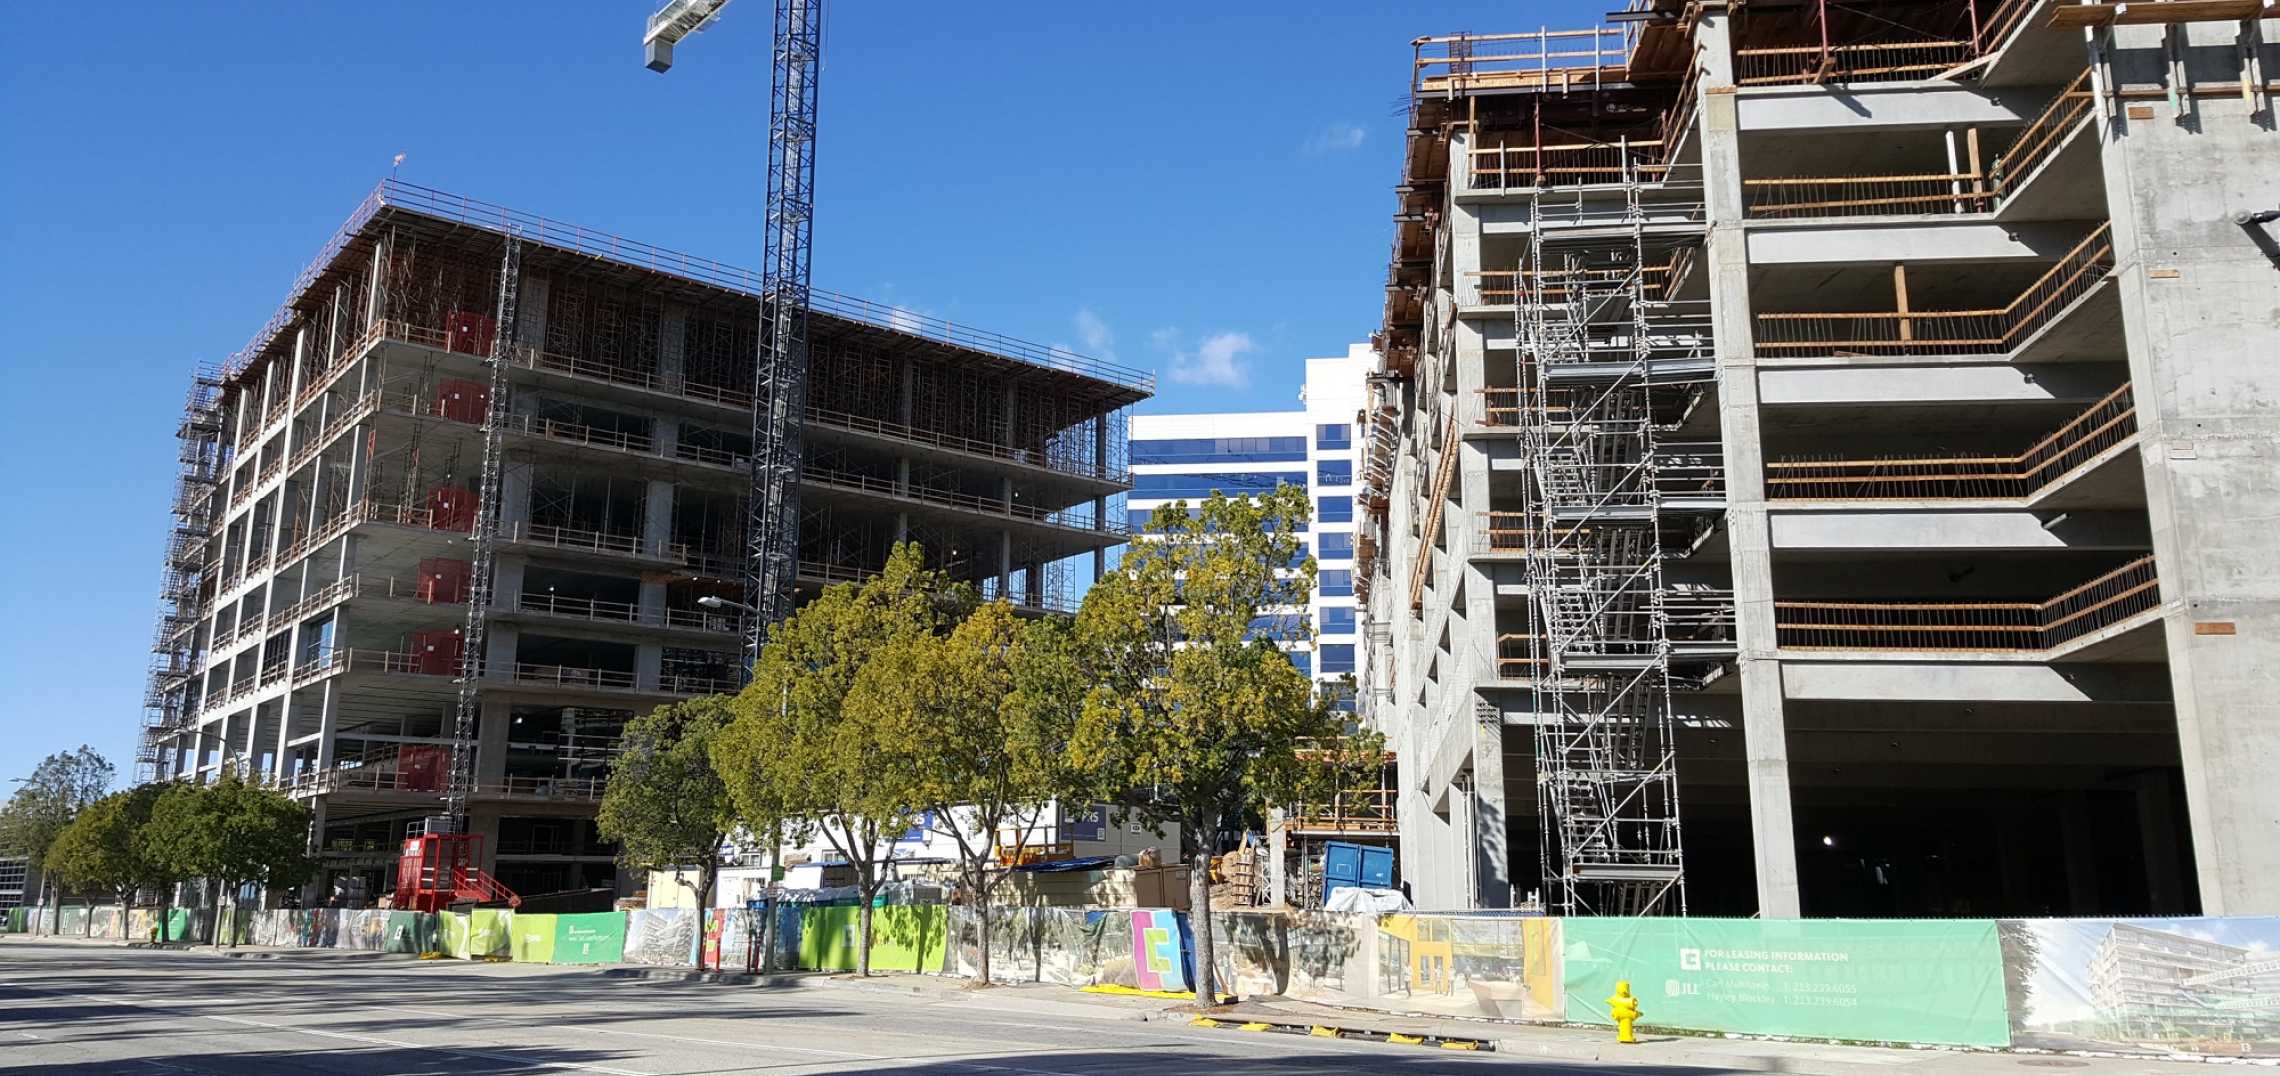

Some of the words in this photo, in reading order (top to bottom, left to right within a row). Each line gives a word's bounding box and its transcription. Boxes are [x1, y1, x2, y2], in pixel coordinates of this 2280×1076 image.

[1704, 949, 1725, 959] FOR
[1726, 949, 1769, 960] LEASING
[1771, 951, 1849, 962] INFORMATION
[1704, 961, 1740, 972] PLEASE
